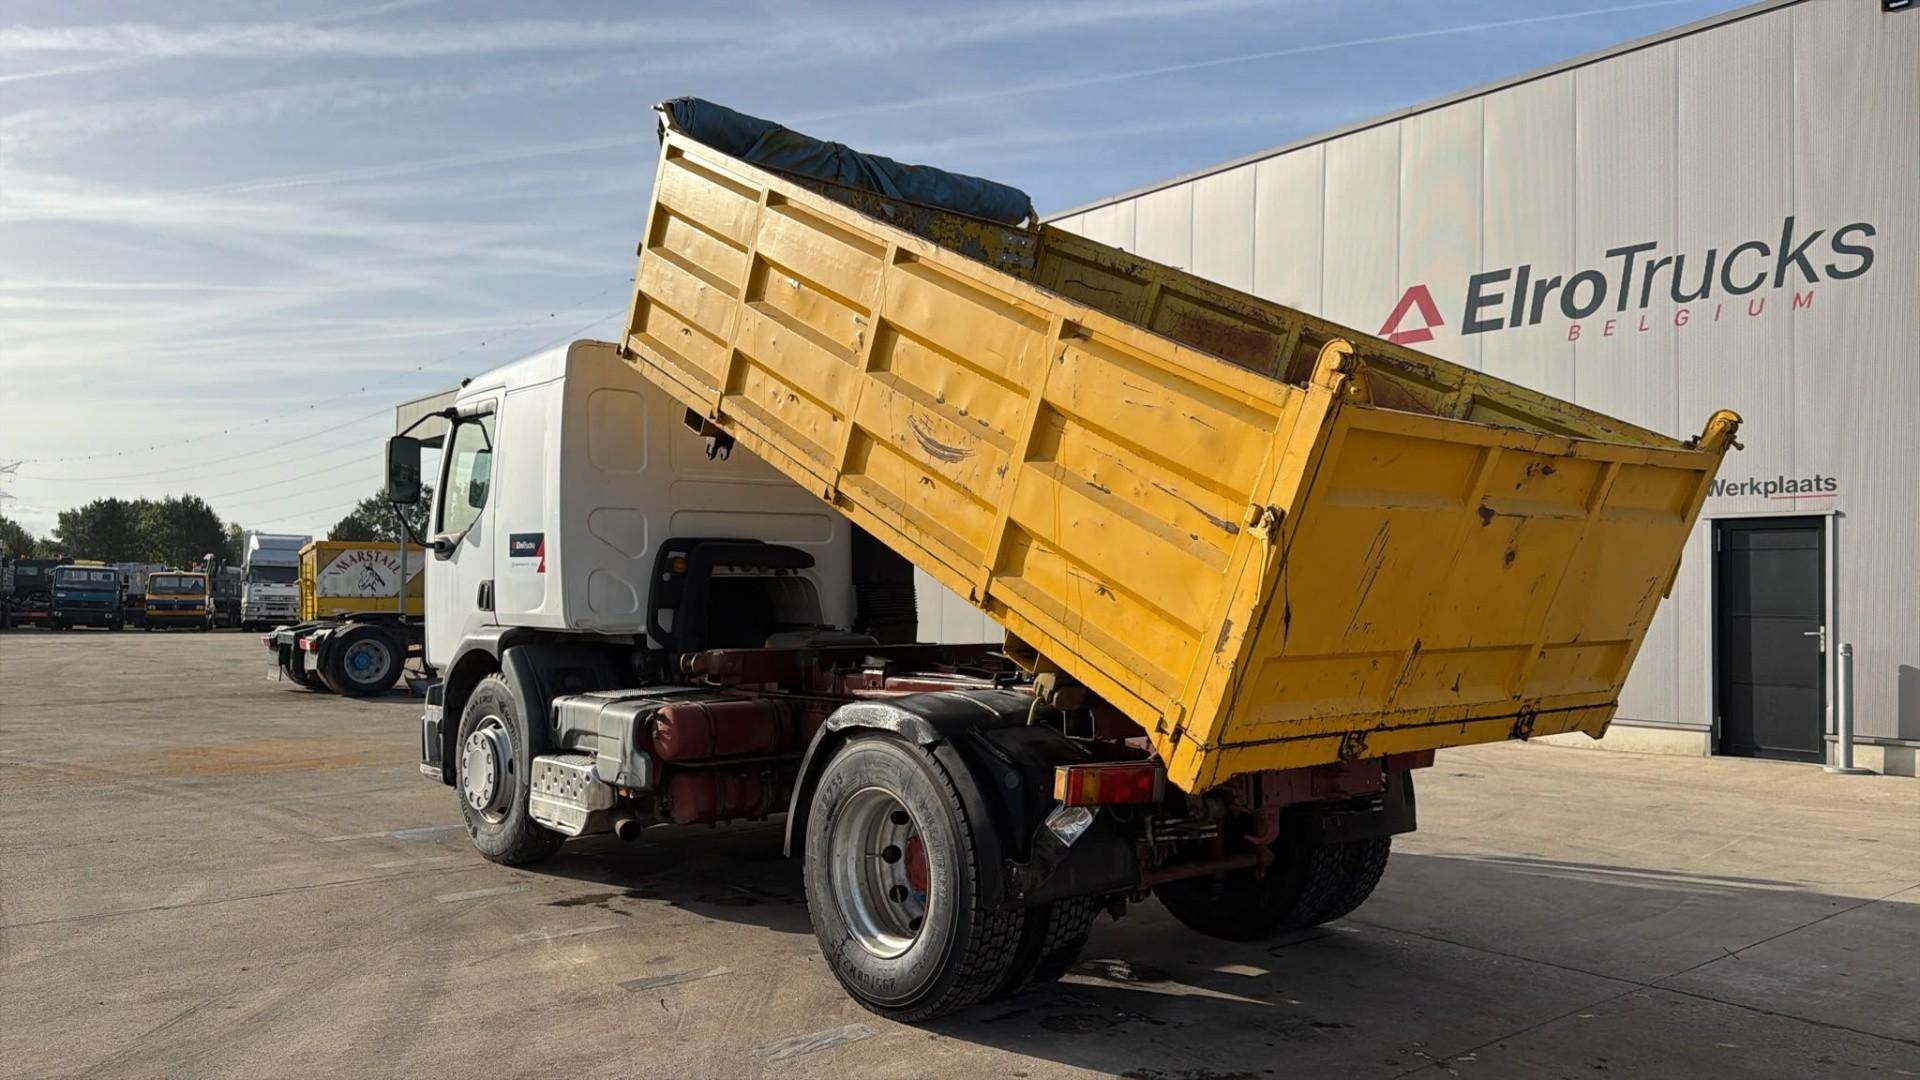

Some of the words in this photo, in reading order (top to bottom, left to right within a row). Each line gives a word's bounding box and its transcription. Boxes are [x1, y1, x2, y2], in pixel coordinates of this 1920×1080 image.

[1461, 216, 1877, 336] ElroTrucks
[1567, 291, 1815, 341] BELGIUM
[1707, 474, 1838, 499] Werkplaats
[335, 550, 402, 576] MARSTALL
